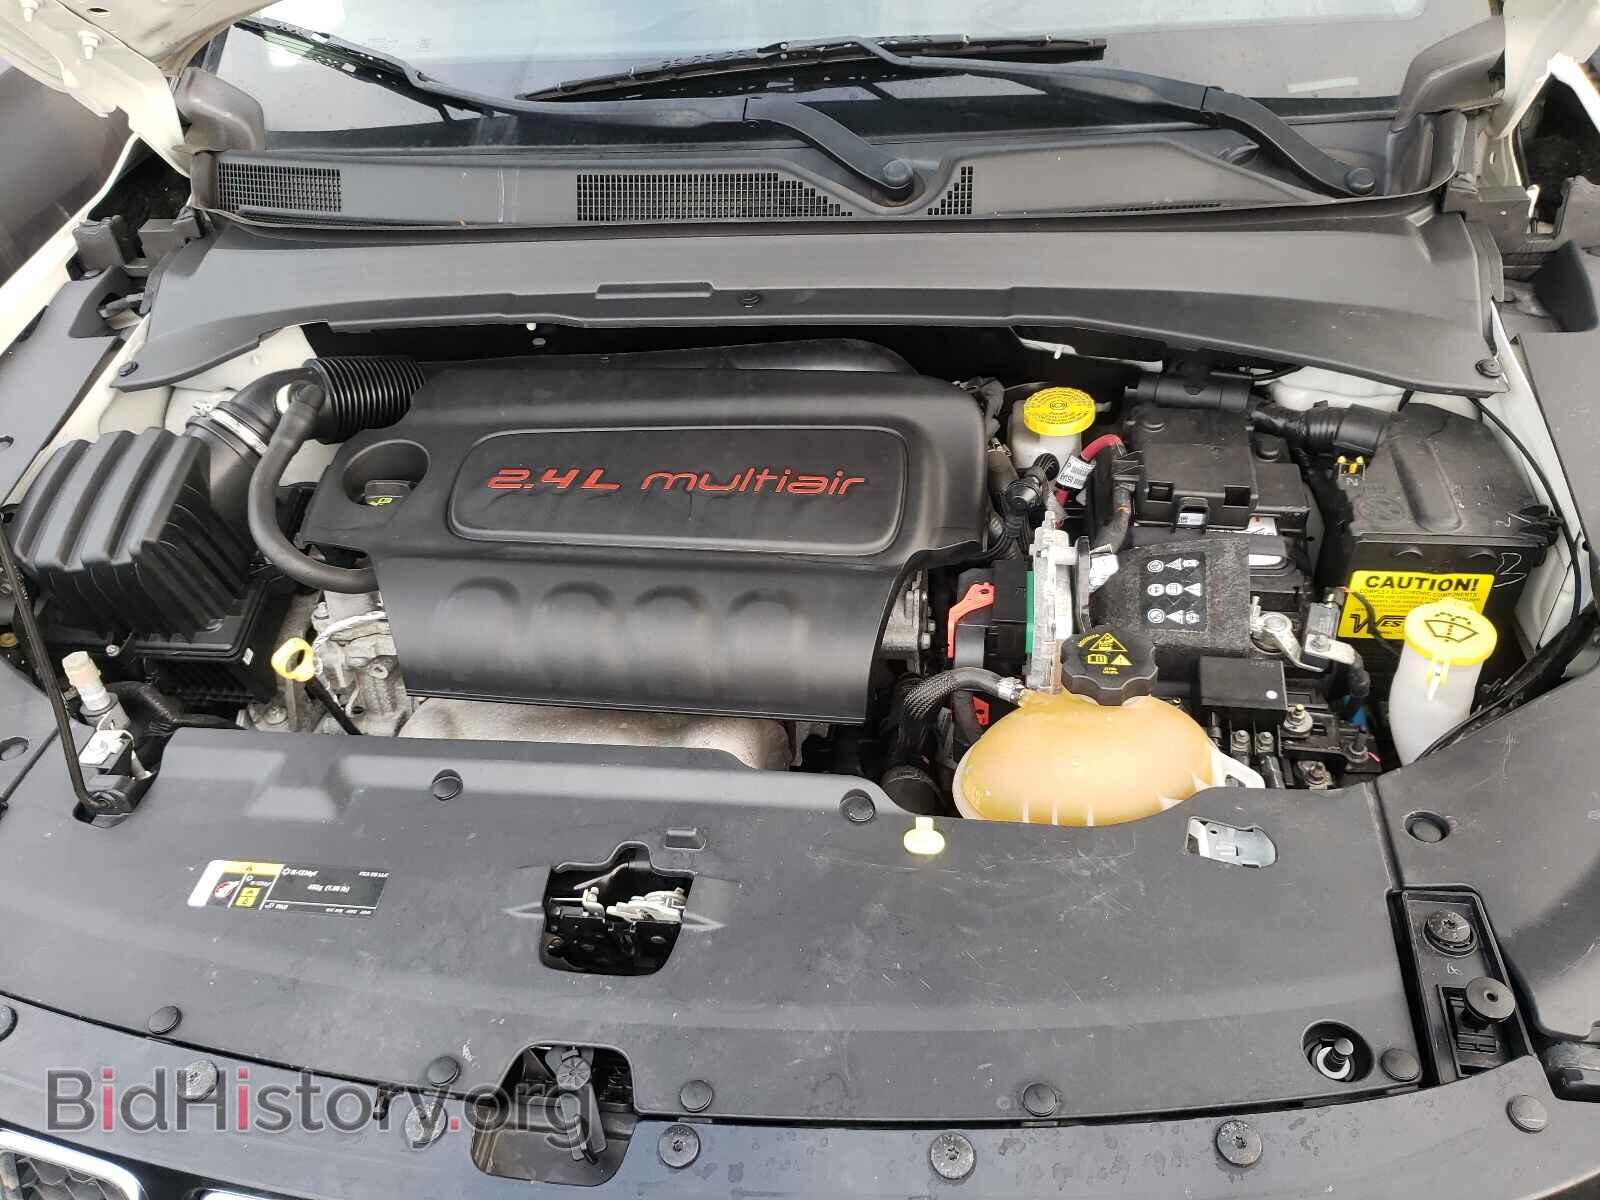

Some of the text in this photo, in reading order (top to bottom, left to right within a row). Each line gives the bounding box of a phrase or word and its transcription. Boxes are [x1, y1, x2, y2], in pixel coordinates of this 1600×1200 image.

[487, 466, 866, 496] 2.4L multiair
[1364, 575, 1481, 592] CAUTION!
